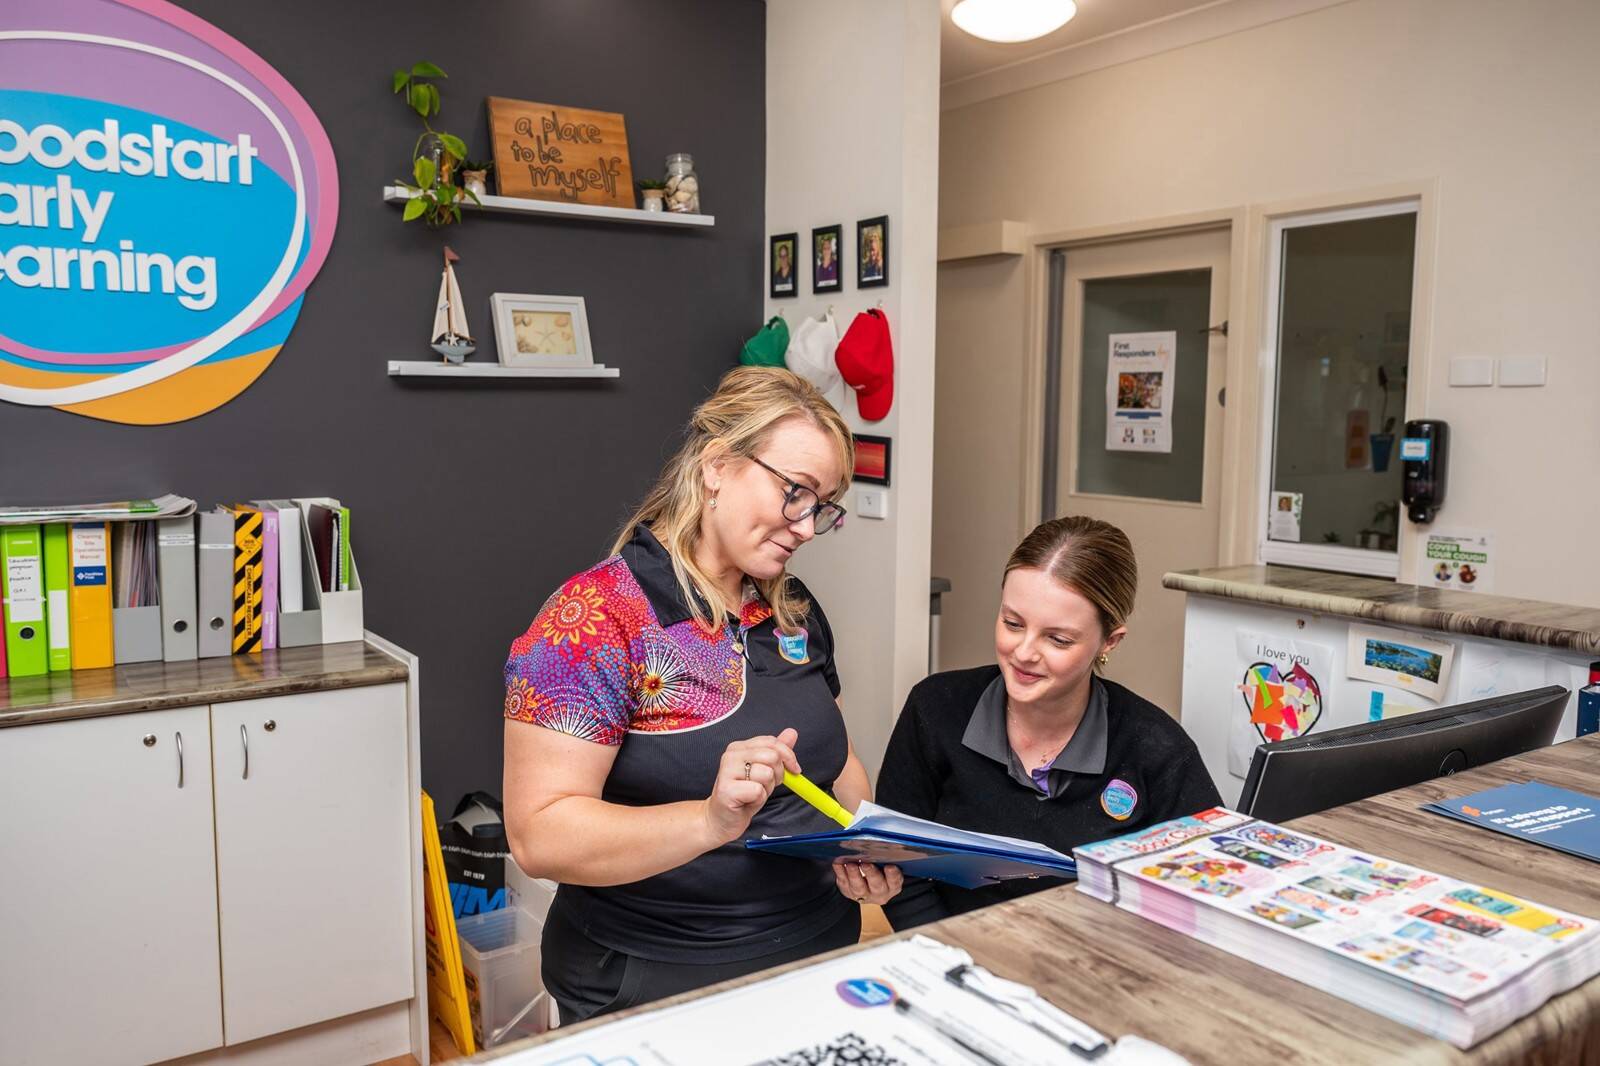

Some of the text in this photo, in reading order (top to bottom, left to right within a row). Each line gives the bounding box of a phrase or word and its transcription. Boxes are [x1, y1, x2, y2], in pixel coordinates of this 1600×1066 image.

[515, 110, 603, 145] a place
[511, 135, 563, 165] to be
[528, 156, 622, 201] myself
[0, 240, 218, 311] arning
[1113, 349, 1156, 358] Responders
[1114, 342, 1130, 350] First
[1428, 543, 1458, 553] COVER
[1428, 551, 1487, 563] YOUR COUGH
[1263, 645, 1286, 660] love
[1289, 653, 1310, 666] you
[463, 869, 472, 878] EST
